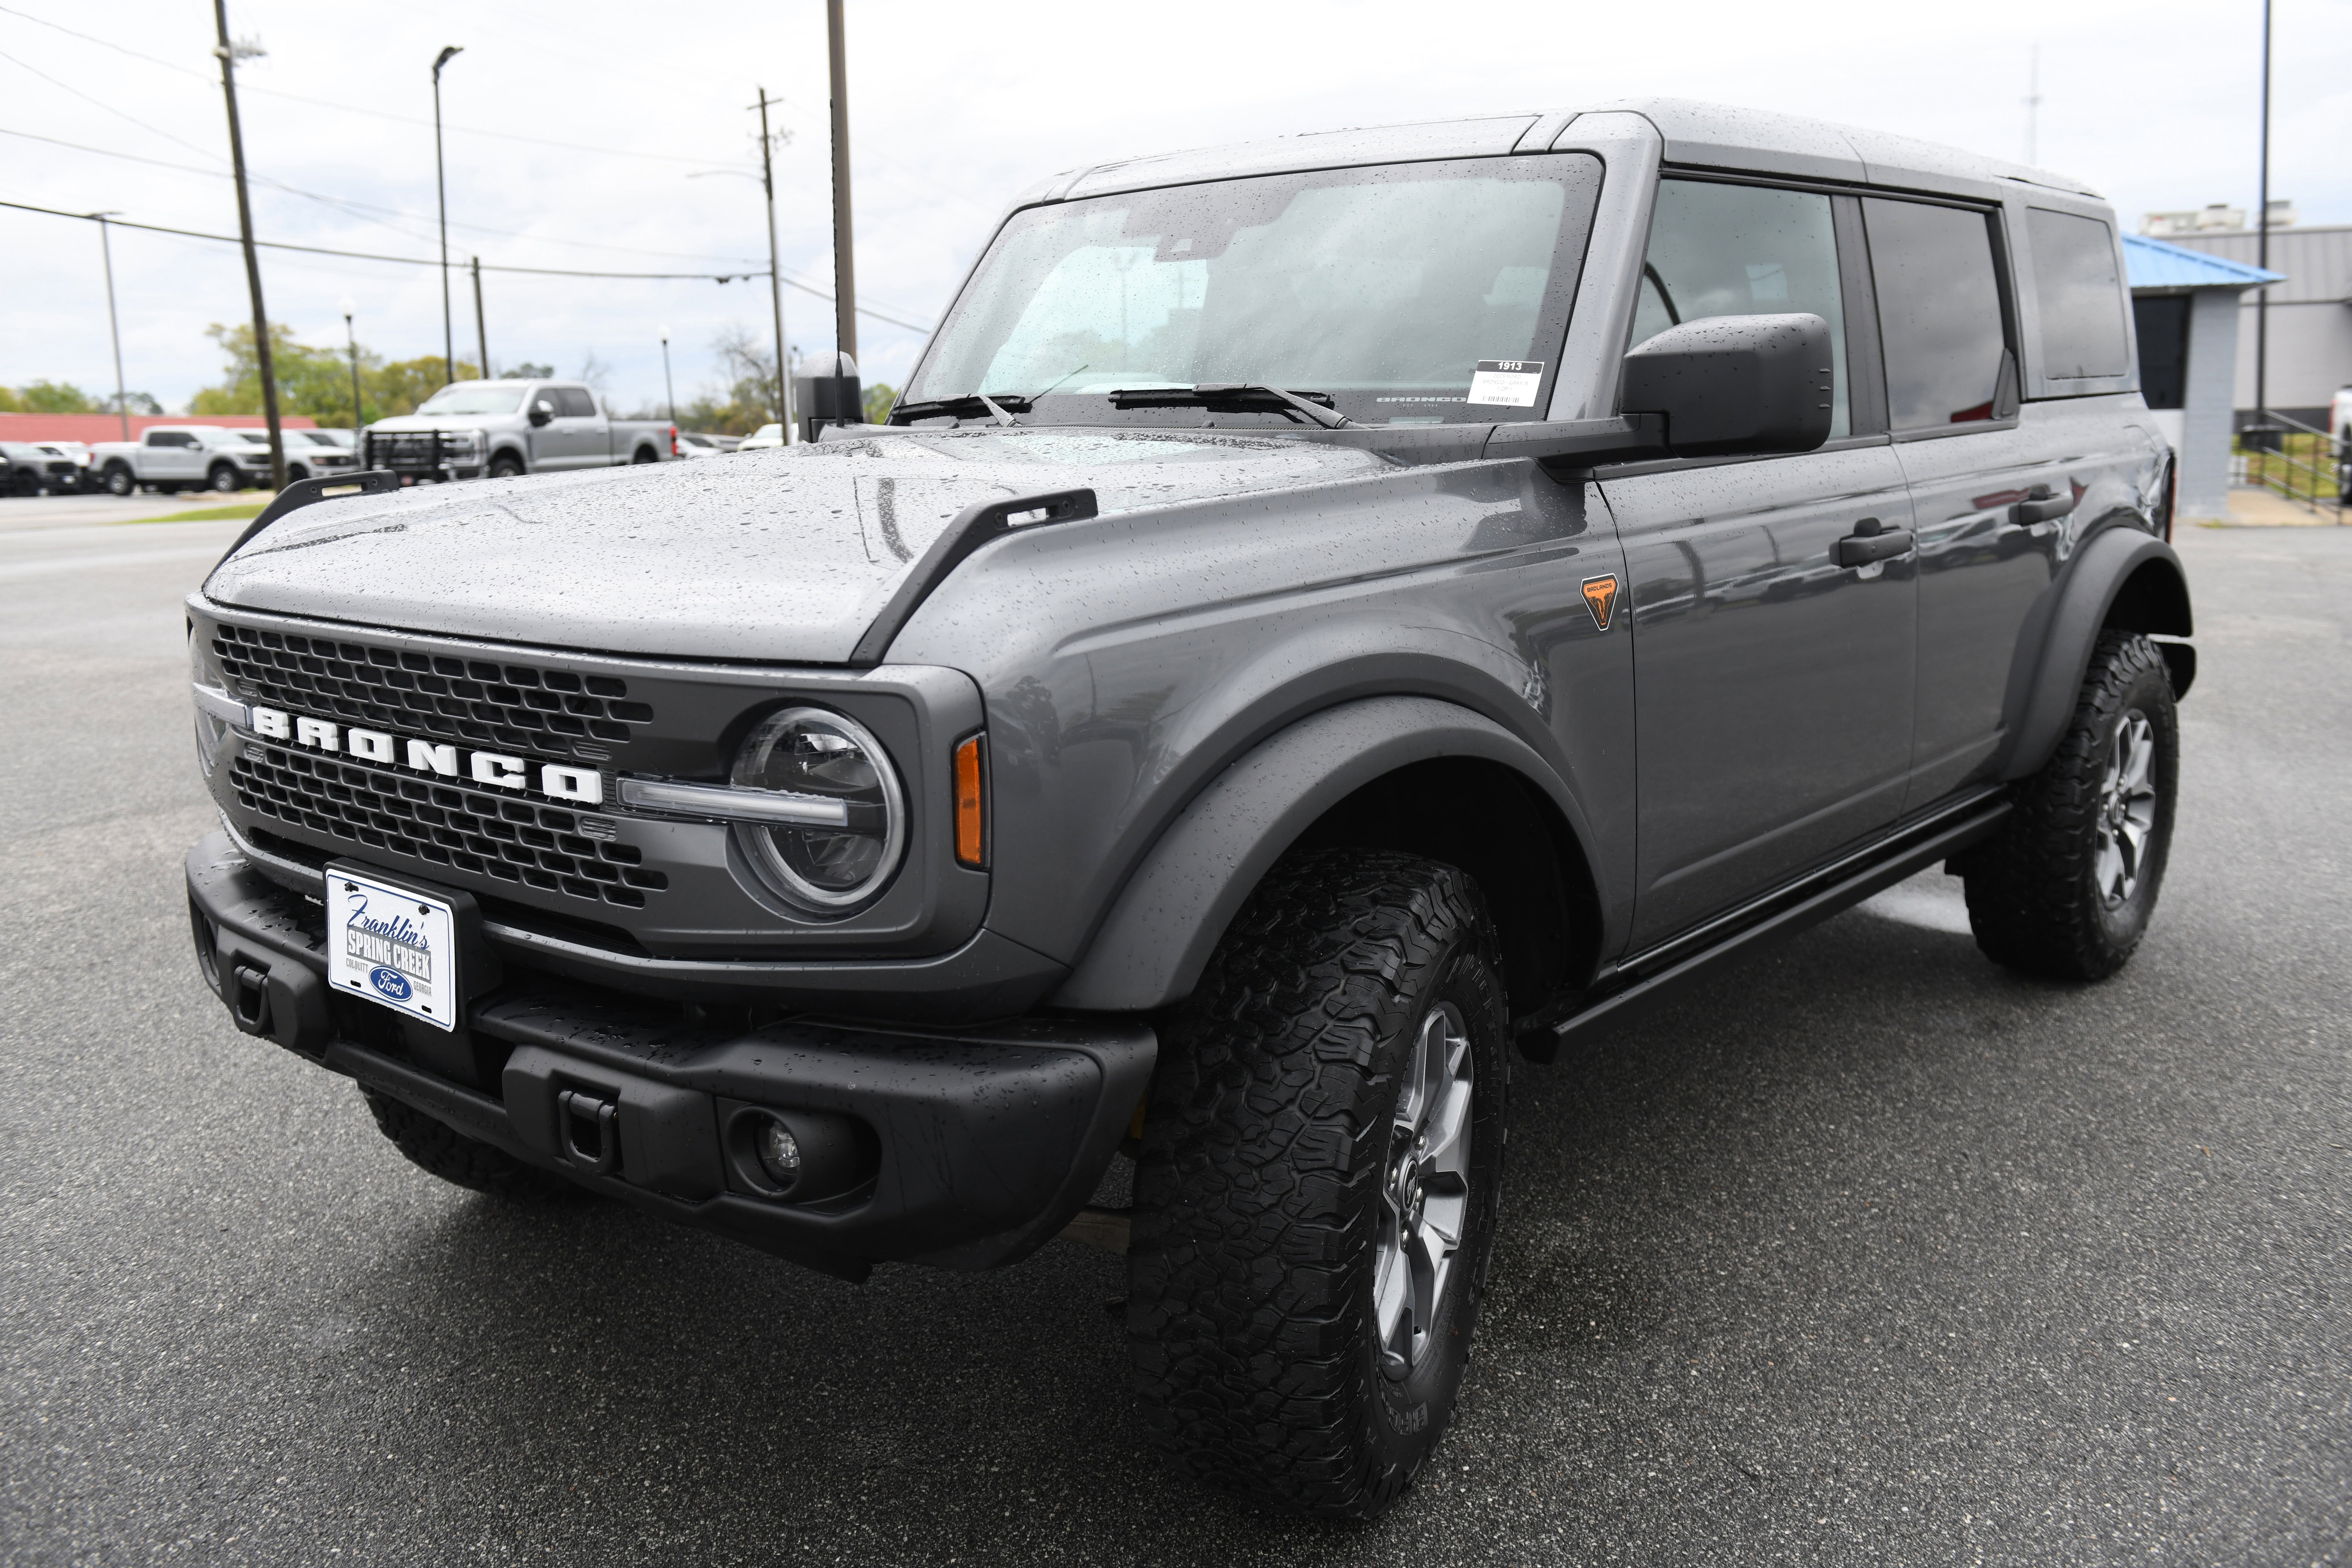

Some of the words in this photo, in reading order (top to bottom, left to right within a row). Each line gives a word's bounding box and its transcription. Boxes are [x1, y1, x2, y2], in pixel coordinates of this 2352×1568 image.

[1498, 362, 1522, 370] 1913
[1587, 583, 1613, 592] BADLANDS
[253, 706, 603, 804] BRONCO
[347, 894, 430, 950] Franklin's
[346, 958, 368, 973] COLQUITT
[348, 930, 392, 965] SPRING
[393, 944, 430, 980] CREEK
[378, 970, 404, 996] Ford
[413, 980, 432, 996] GEORGIA
